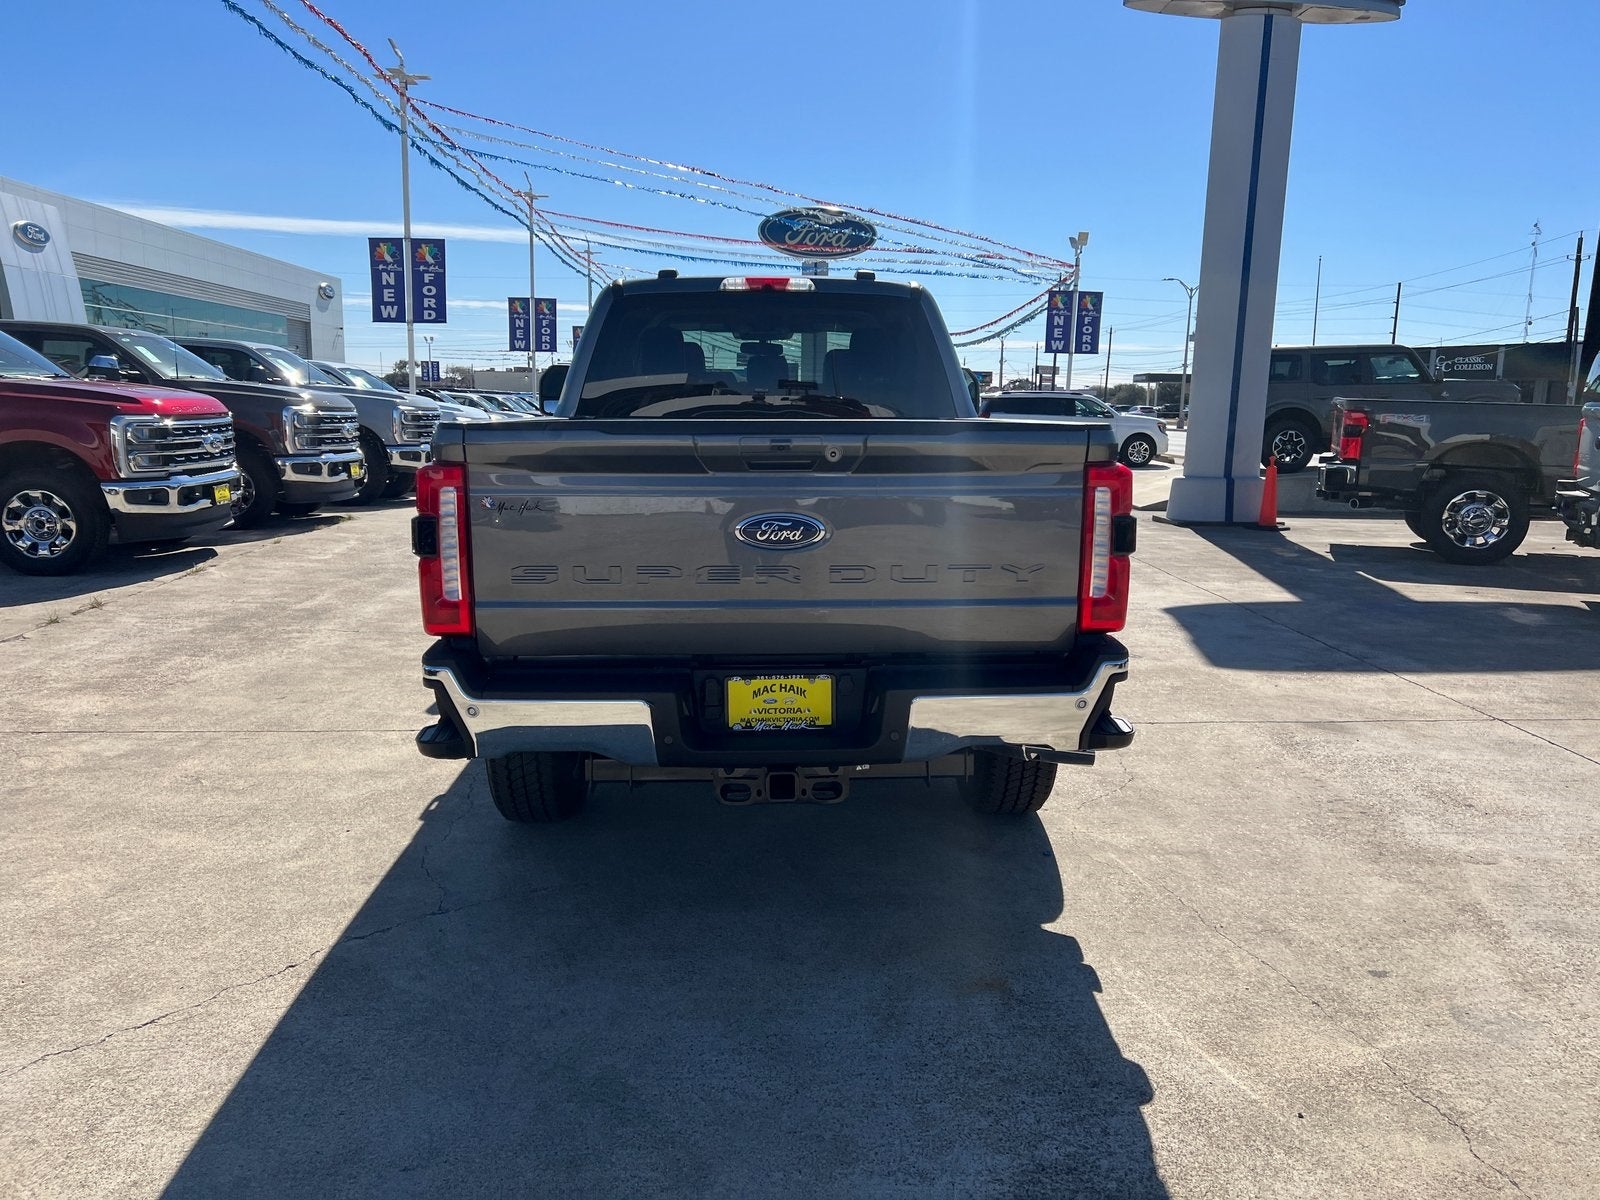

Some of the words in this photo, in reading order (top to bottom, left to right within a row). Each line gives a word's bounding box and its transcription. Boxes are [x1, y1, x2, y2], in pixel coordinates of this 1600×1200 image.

[785, 217, 852, 247] Ford
[380, 271, 398, 319] NEW
[422, 273, 437, 320] FORD
[514, 318, 526, 349] NEW
[541, 319, 551, 350] FORD
[1051, 315, 1065, 351] NEW
[1081, 316, 1093, 352] FORD
[1454, 356, 1485, 364] CLASSIC
[1454, 363, 1494, 371] COLLISION
[756, 520, 803, 542] Ford
[511, 564, 801, 585] SUPER
[829, 563, 1045, 584] DUTY
[752, 683, 777, 700] MAC
[780, 683, 808, 699] HAIK
[756, 707, 803, 715] VICTORIA
[752, 721, 776, 731] Mac
[780, 720, 812, 731] Haik
